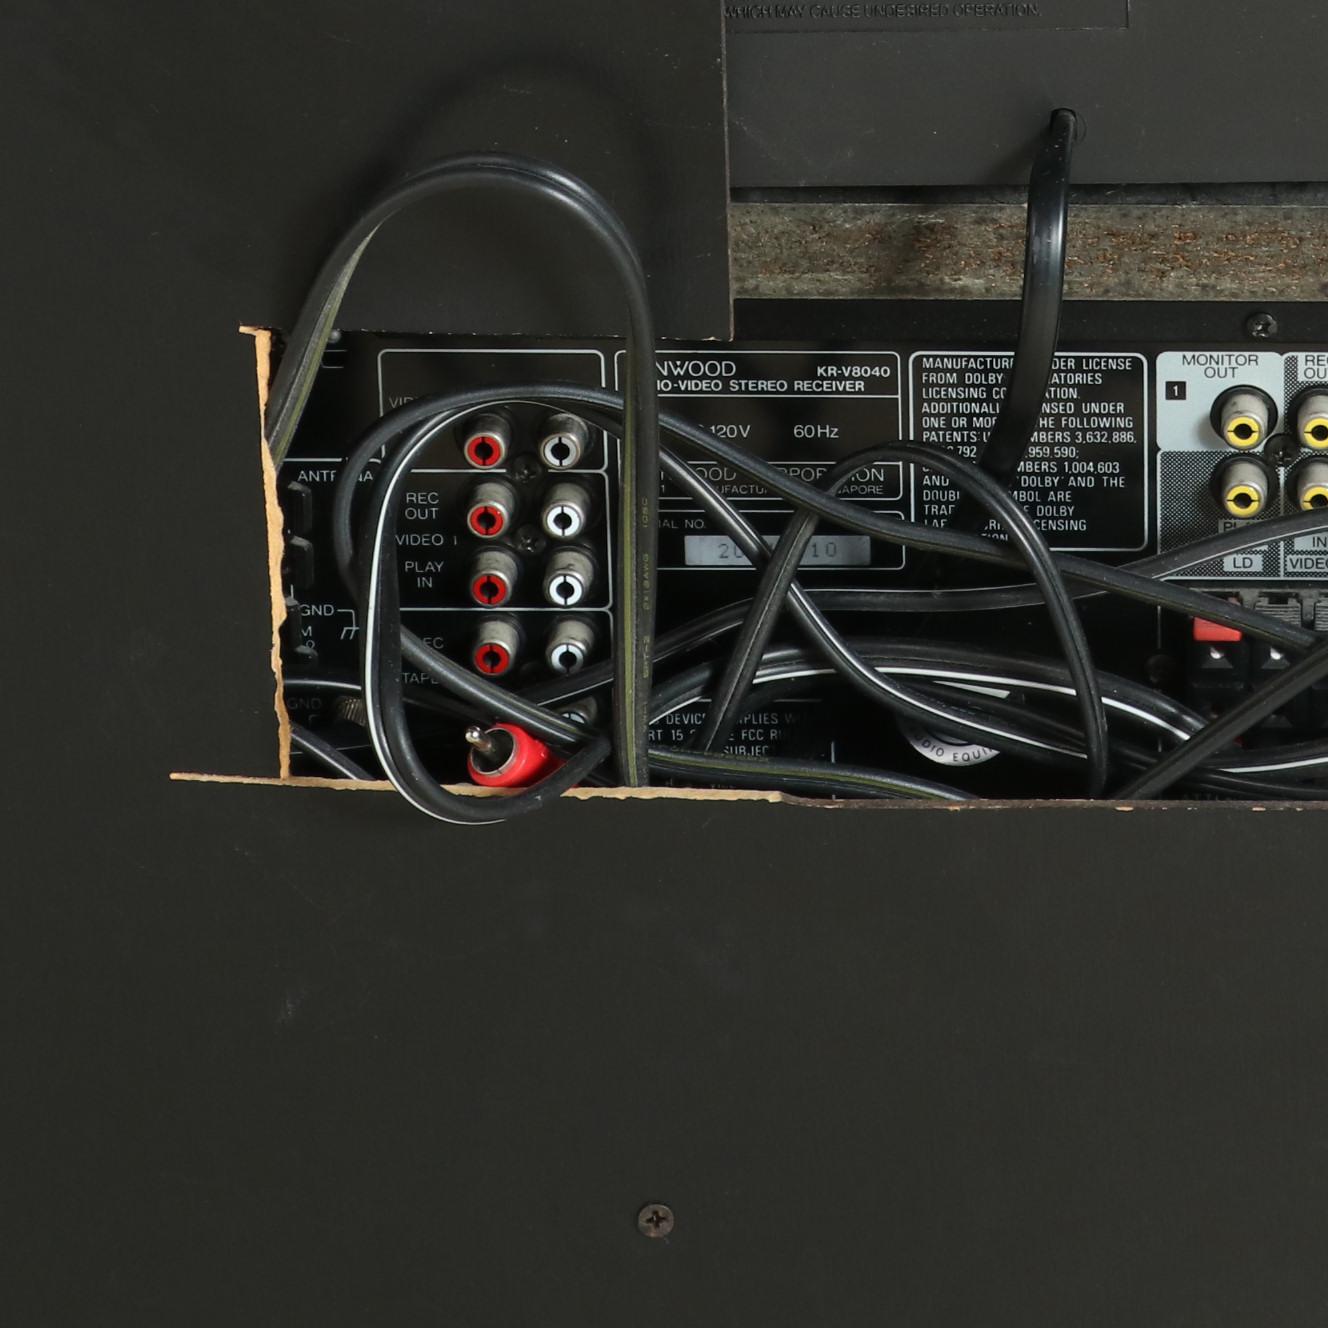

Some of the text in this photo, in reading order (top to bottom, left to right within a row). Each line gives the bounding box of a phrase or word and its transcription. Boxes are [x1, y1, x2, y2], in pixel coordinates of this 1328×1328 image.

[1082, 358, 1132, 370] LICENSE
[1182, 355, 1258, 366] MONITOR
[817, 366, 890, 377] KR-V8040
[1204, 367, 1237, 379] OUT
[922, 373, 1004, 384] FROM DOLBY
[729, 380, 787, 392] STEREO
[794, 380, 864, 392] RECEIVER
[1172, 384, 1179, 396] 1
[922, 388, 986, 399] LICENSING
[1082, 403, 1124, 414] UNDER
[922, 417, 967, 428] ONE OR
[1062, 417, 1133, 428] FOLLOWING
[794, 425, 839, 438] 60Hz
[1068, 476, 1125, 487] AND THE
[406, 492, 439, 504] REC
[1048, 491, 1072, 501] ARE
[405, 508, 440, 520] OUT
[1037, 506, 1075, 517] DOLBY
[684, 520, 706, 528] NO.
[396, 534, 444, 546] VIDEO
[1312, 536, 1327, 548] IN
[405, 561, 444, 573] PLAY
[1233, 557, 1253, 569] LD
[417, 577, 432, 588] IN
